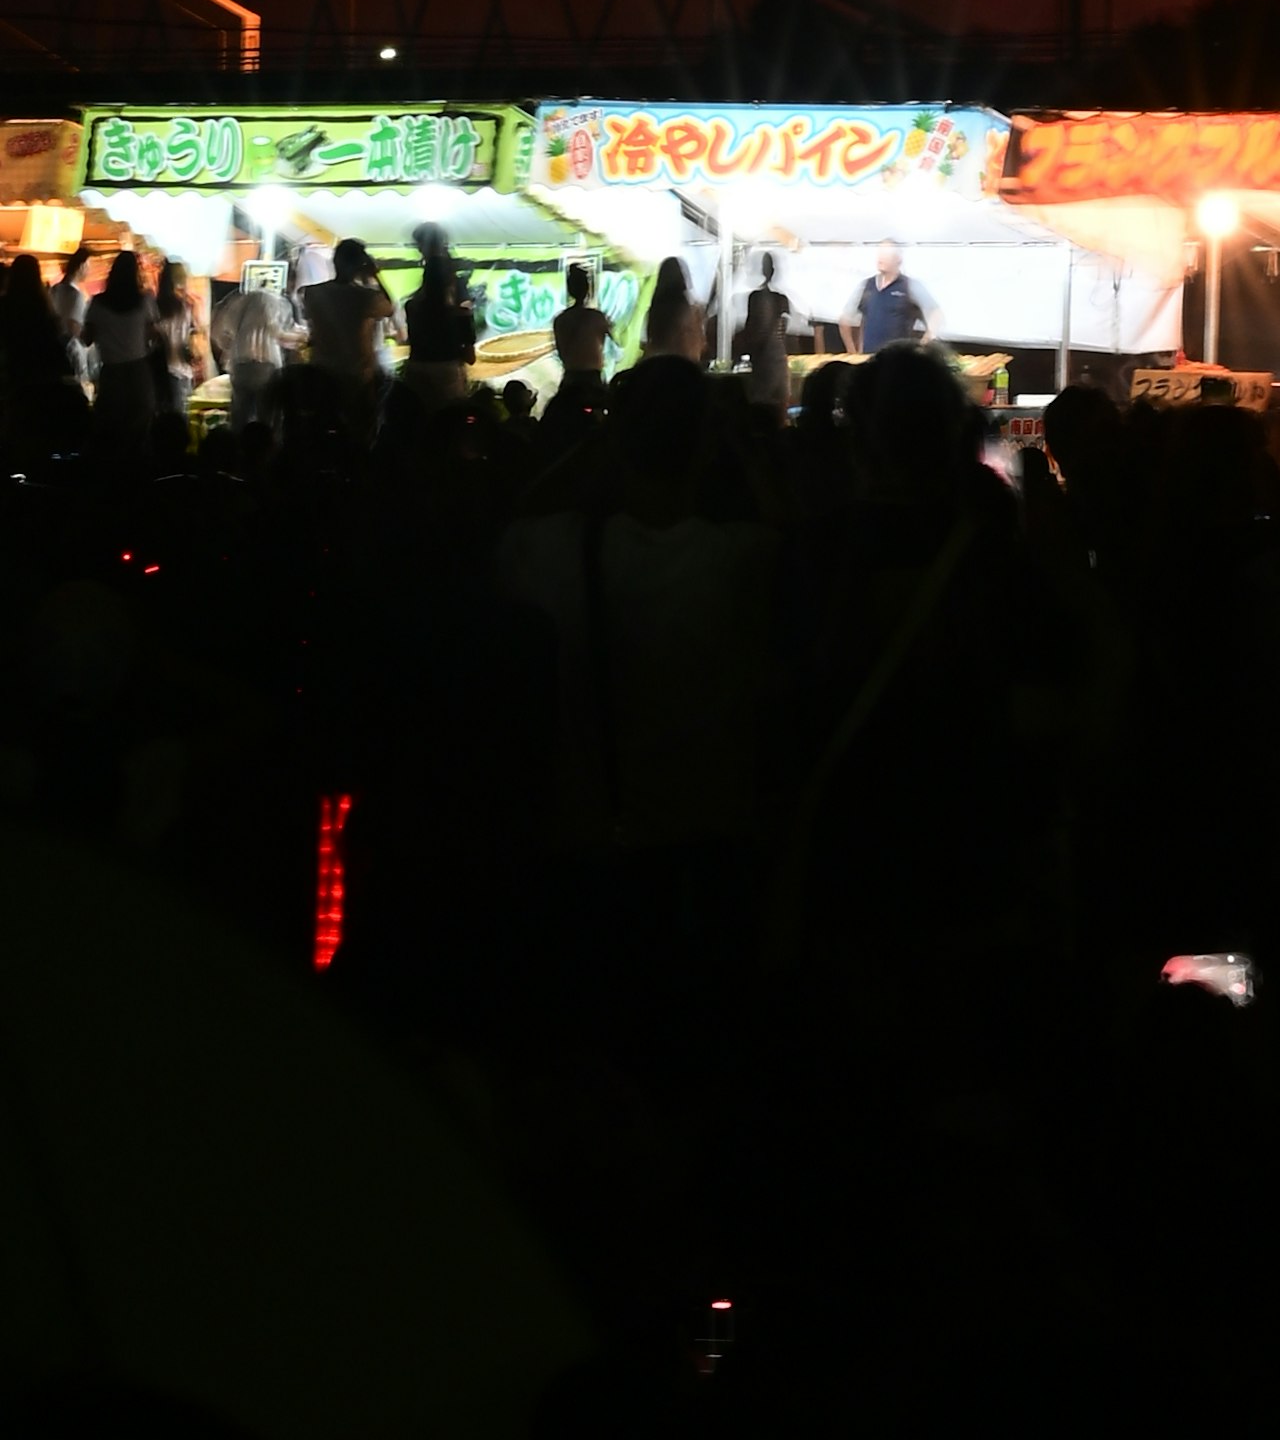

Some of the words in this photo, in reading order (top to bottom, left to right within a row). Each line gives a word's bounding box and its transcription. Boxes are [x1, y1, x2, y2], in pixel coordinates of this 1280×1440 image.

[100, 117, 243, 181] きゅうり
[319, 114, 481, 180] 一本漬け
[604, 116, 898, 178] 冷やしパイン
[487, 270, 637, 330] きゅり
